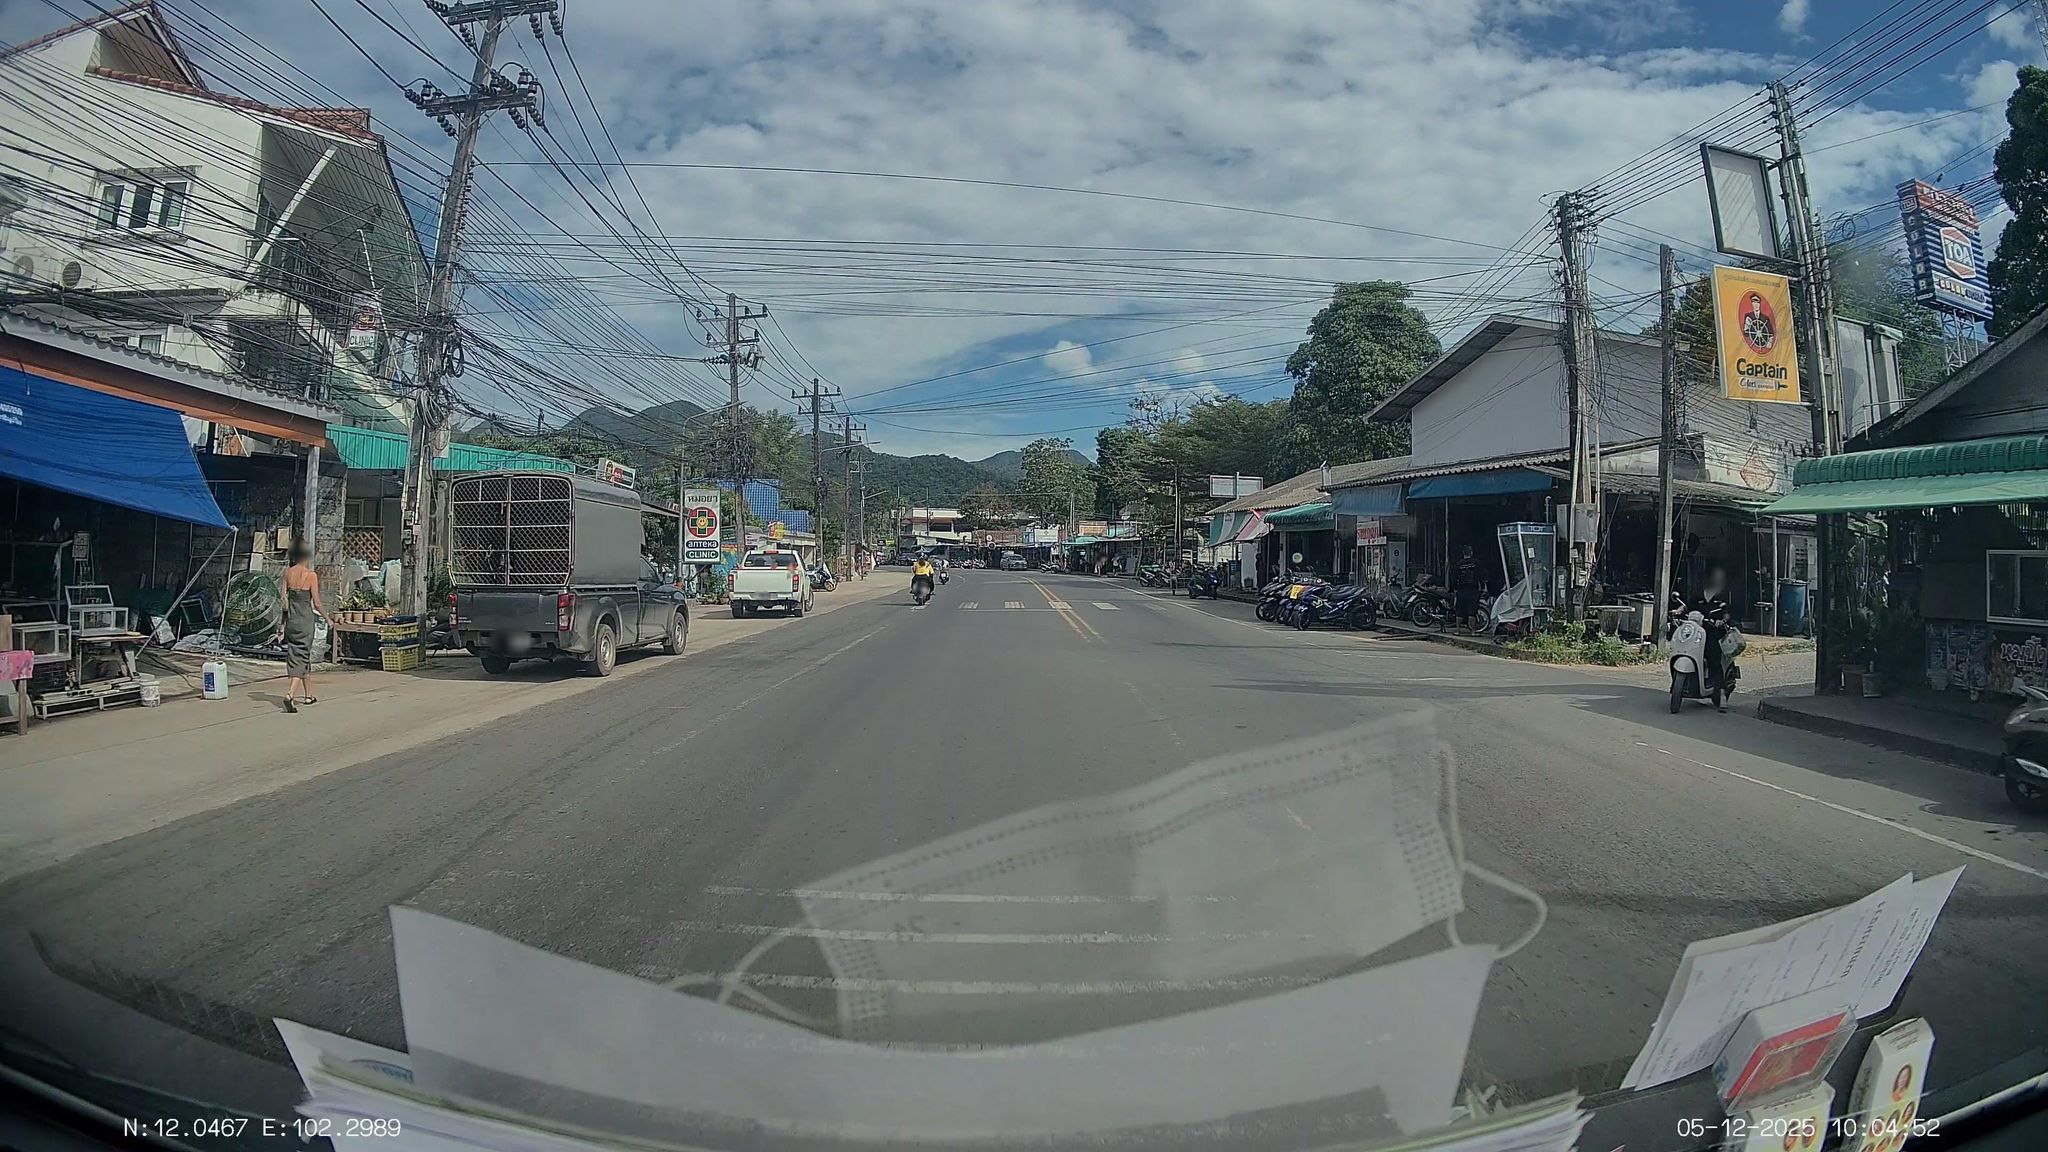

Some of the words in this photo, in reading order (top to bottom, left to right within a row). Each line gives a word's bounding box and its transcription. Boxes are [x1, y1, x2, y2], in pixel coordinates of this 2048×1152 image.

[1946, 242, 1973, 266] TOA
[1737, 358, 1787, 379] Captain
[688, 495, 718, 503] หมอยา
